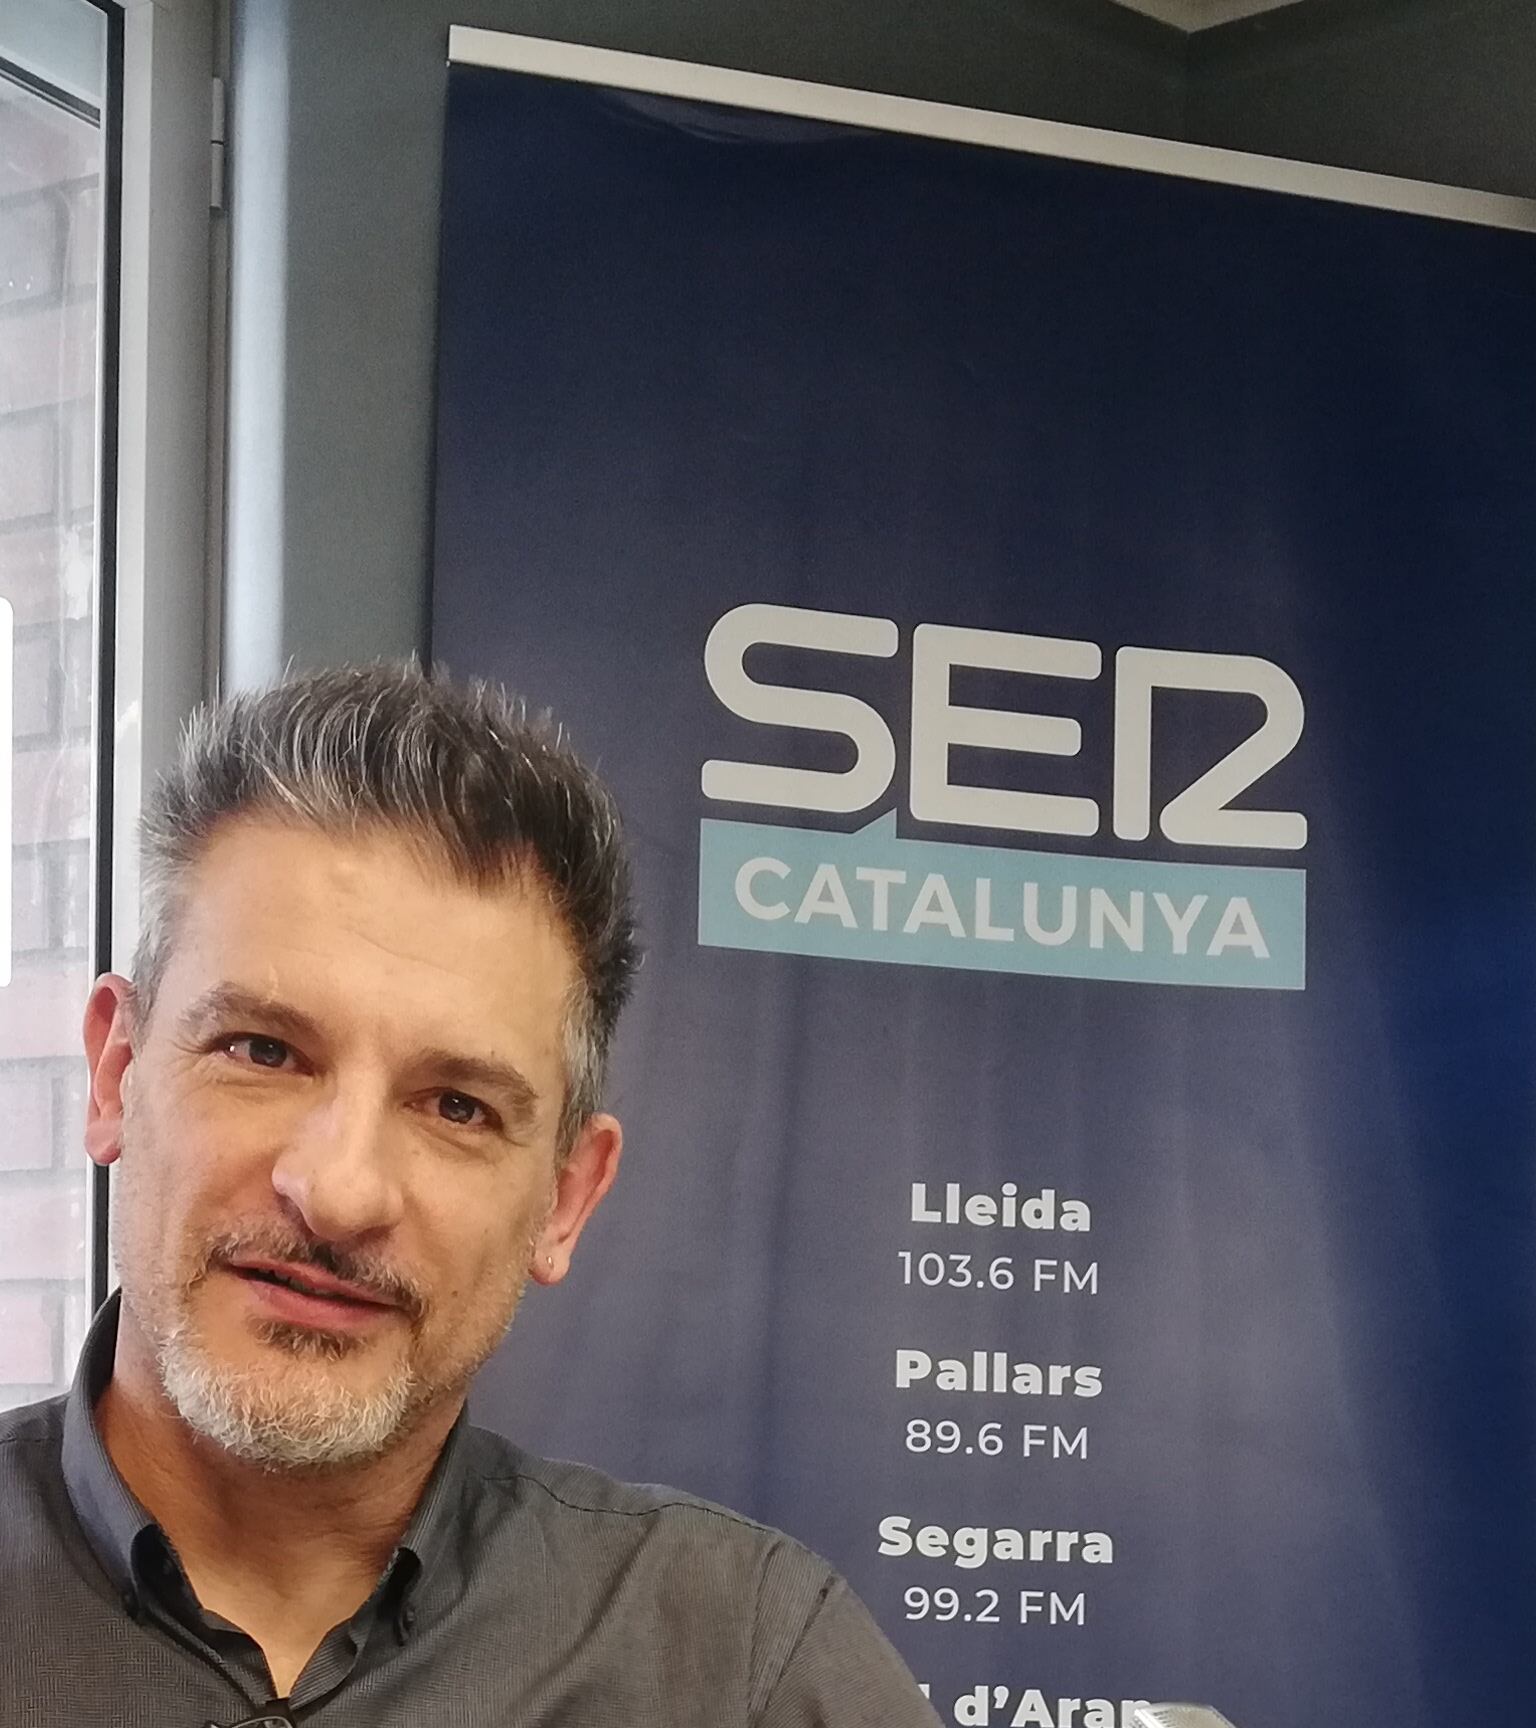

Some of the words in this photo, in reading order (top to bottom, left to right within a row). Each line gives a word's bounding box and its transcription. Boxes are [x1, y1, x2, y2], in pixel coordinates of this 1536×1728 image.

[701, 603, 1308, 850] SER
[734, 857, 1270, 958] CATALUNYA
[911, 1182, 1091, 1232] Lleida
[898, 1251, 1014, 1290] 103.6
[1034, 1259, 1098, 1294] FM
[896, 1349, 1102, 1398] Pallars
[905, 1419, 1003, 1455] 89.6
[1023, 1425, 1088, 1459] FM
[877, 1516, 1113, 1569] Segarra
[904, 1587, 1000, 1622] 99.2
[1019, 1591, 1085, 1626] FM
